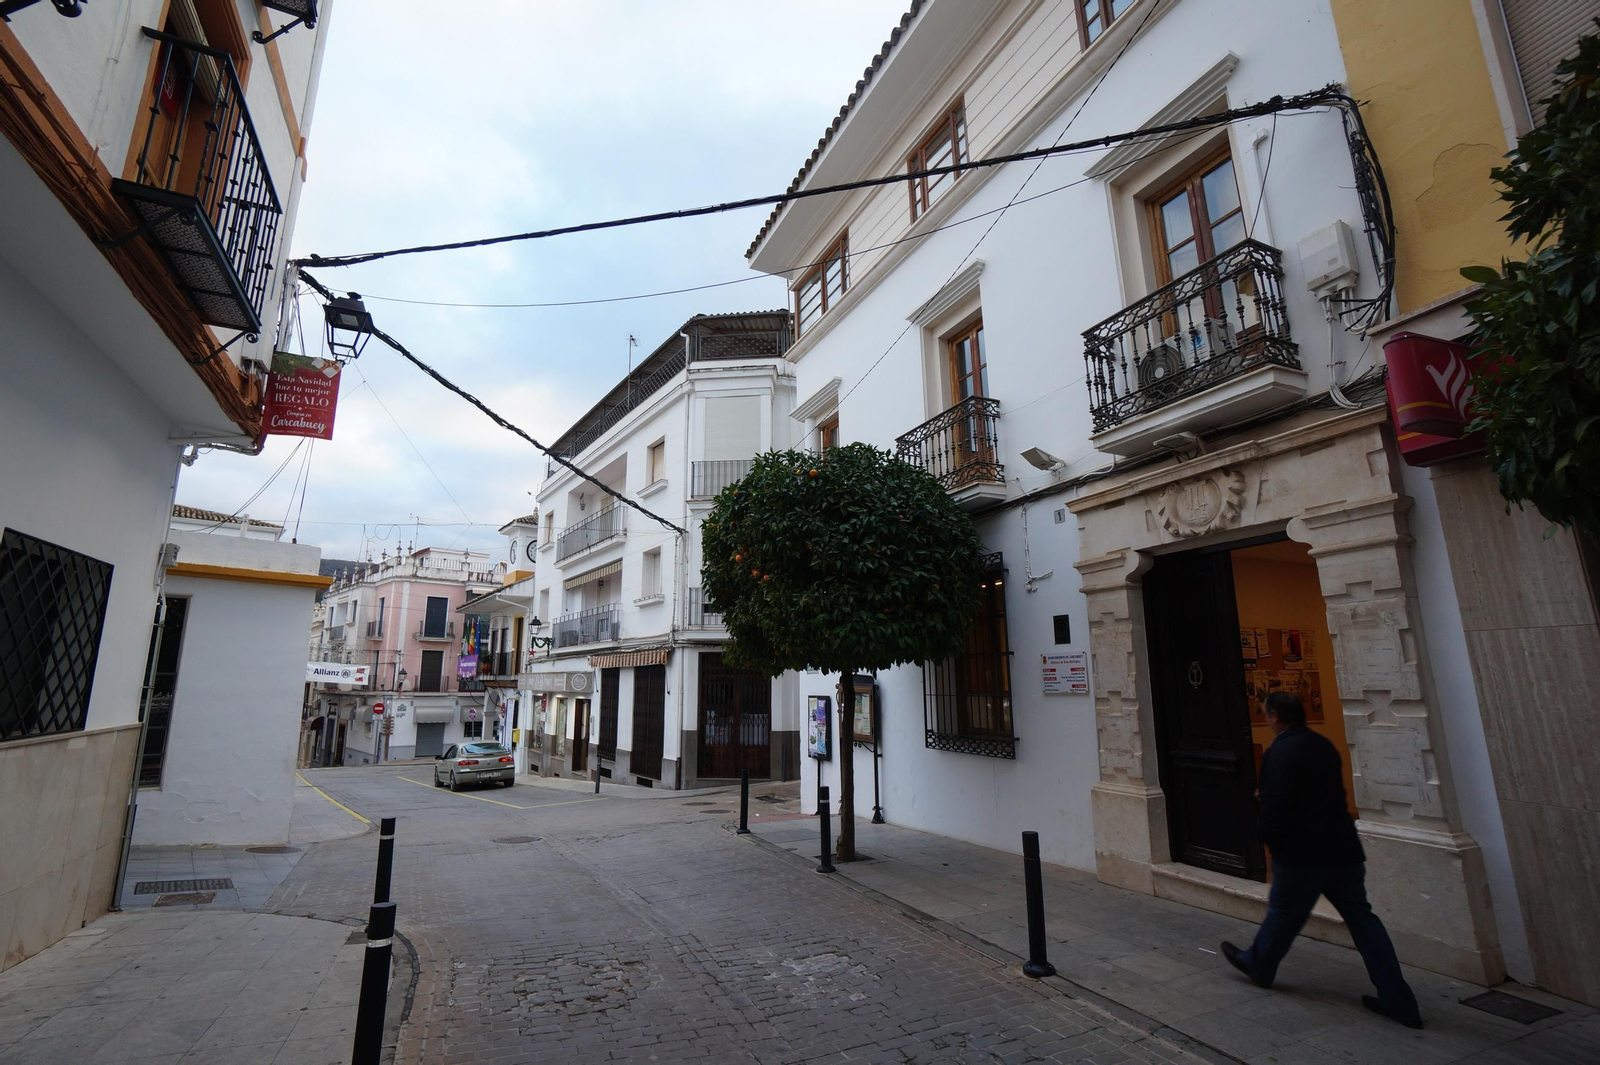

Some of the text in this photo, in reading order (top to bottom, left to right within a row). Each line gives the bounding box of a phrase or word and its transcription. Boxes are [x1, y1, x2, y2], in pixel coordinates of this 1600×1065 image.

[277, 374, 332, 387] Esta Navidad
[275, 382, 330, 395] haz tu mejor
[275, 393, 329, 407] REGALO
[271, 415, 326, 433] Carcabuey
[313, 668, 340, 676] Allianz
